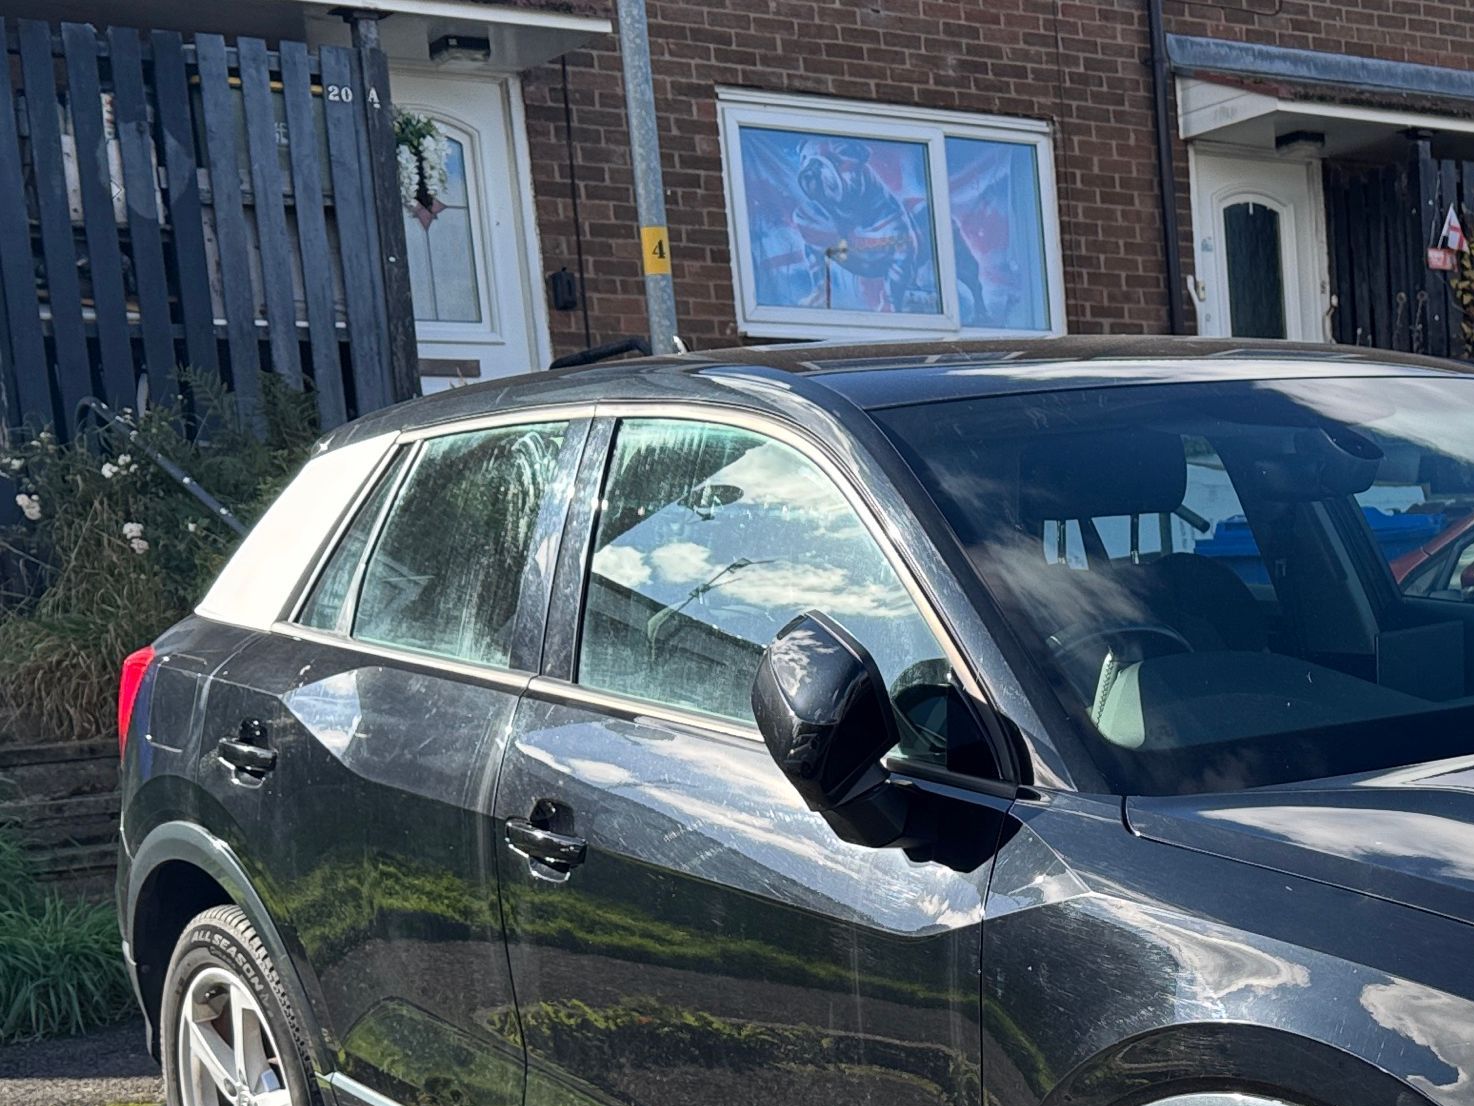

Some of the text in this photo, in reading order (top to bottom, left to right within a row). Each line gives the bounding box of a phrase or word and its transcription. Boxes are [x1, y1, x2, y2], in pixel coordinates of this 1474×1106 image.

[327, 85, 380, 109] 20 A
[652, 239, 666, 259] 4
[191, 930, 212, 943] ALL
[211, 933, 264, 992] SEASON
